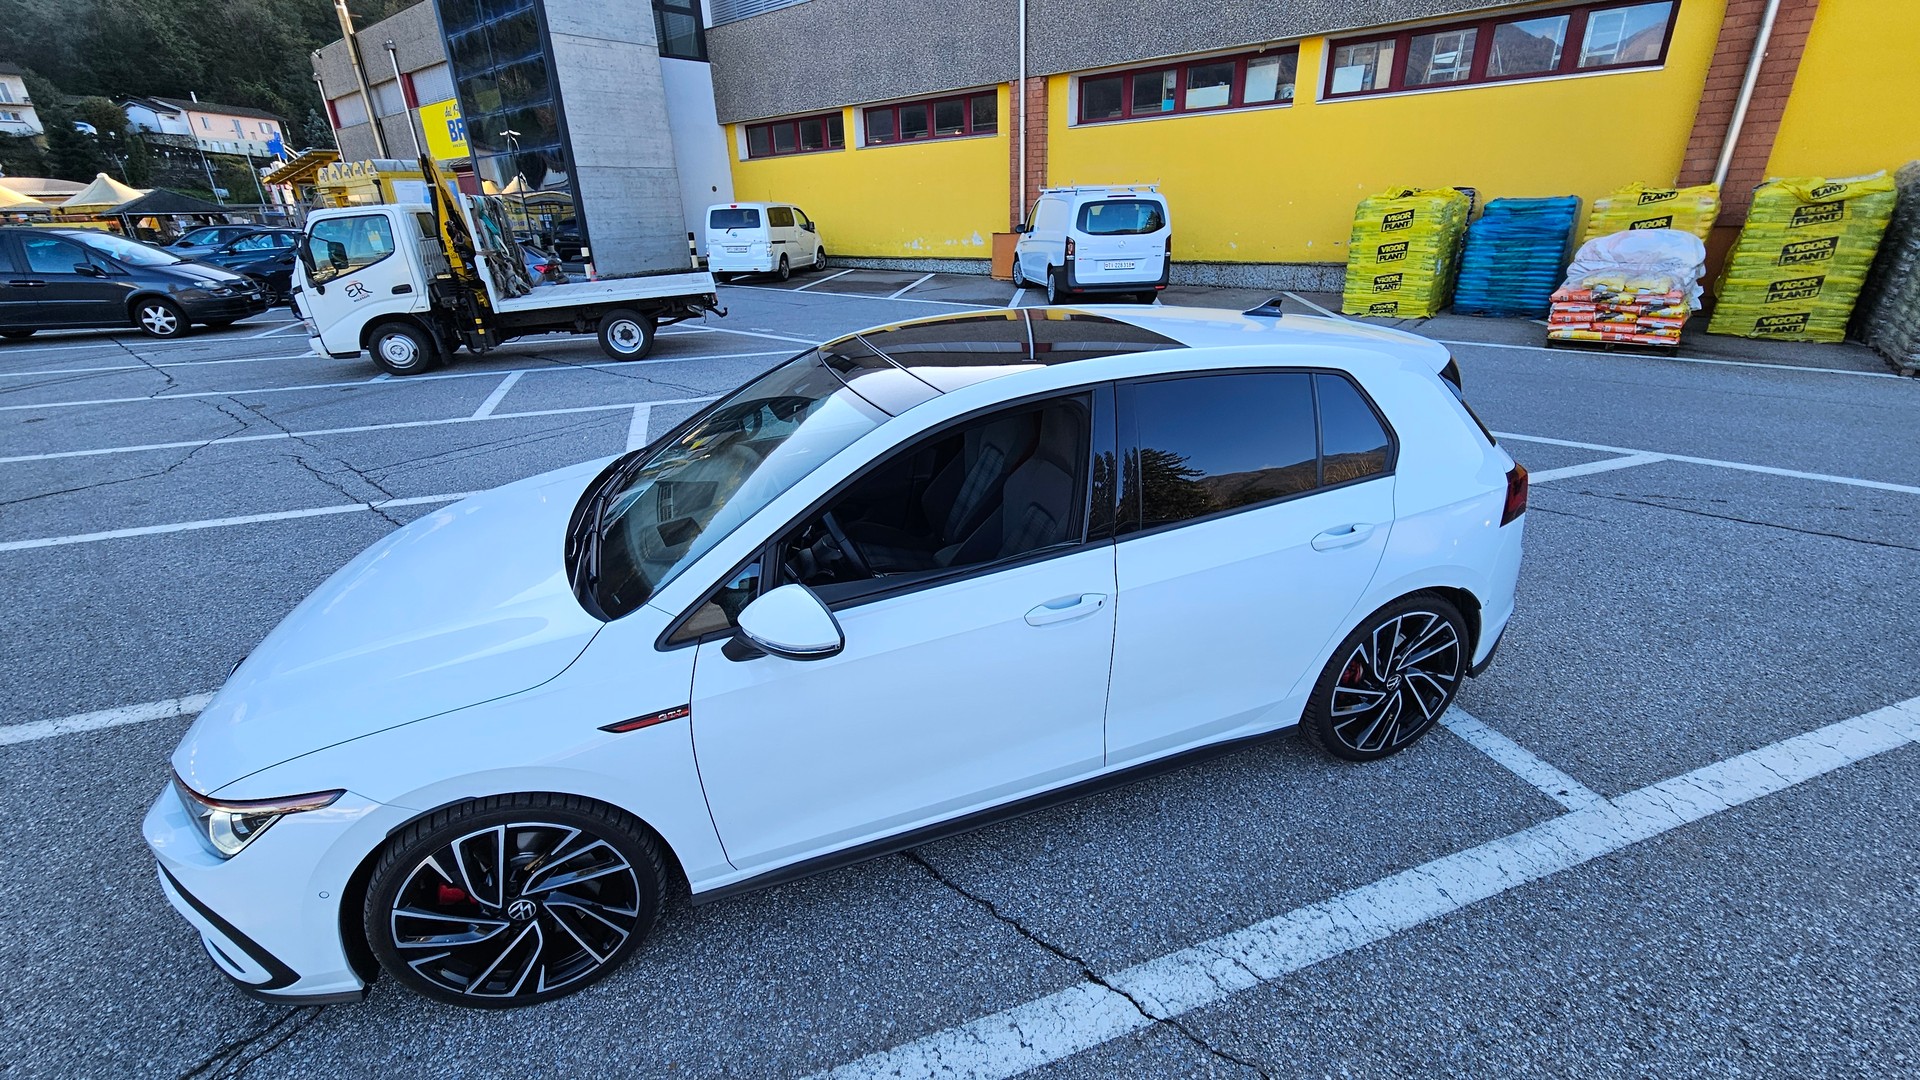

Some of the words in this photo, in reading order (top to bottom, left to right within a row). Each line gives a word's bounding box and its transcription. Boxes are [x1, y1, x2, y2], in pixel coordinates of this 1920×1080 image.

[1642, 191, 1674, 203] PLANT
[1811, 184, 1843, 198] PLANT
[1800, 202, 1840, 215] VIGOR
[1387, 211, 1411, 222] VIGOR
[1795, 212, 1837, 226] PLANT
[1384, 220, 1411, 231] PLANT
[1634, 218, 1668, 230] VIGOR
[1381, 243, 1406, 253] VIGOR
[1788, 239, 1832, 253] VIGOR
[1379, 252, 1404, 262] PLANT
[1783, 250, 1830, 263] PLANT
[1376, 275, 1400, 283] VIGOR
[1776, 278, 1818, 290] VIGOR
[1375, 283, 1399, 292] PLANT
[1770, 288, 1816, 301] PLANT
[1762, 315, 1803, 326] VIGOR
[1757, 325, 1801, 333] PLANT
